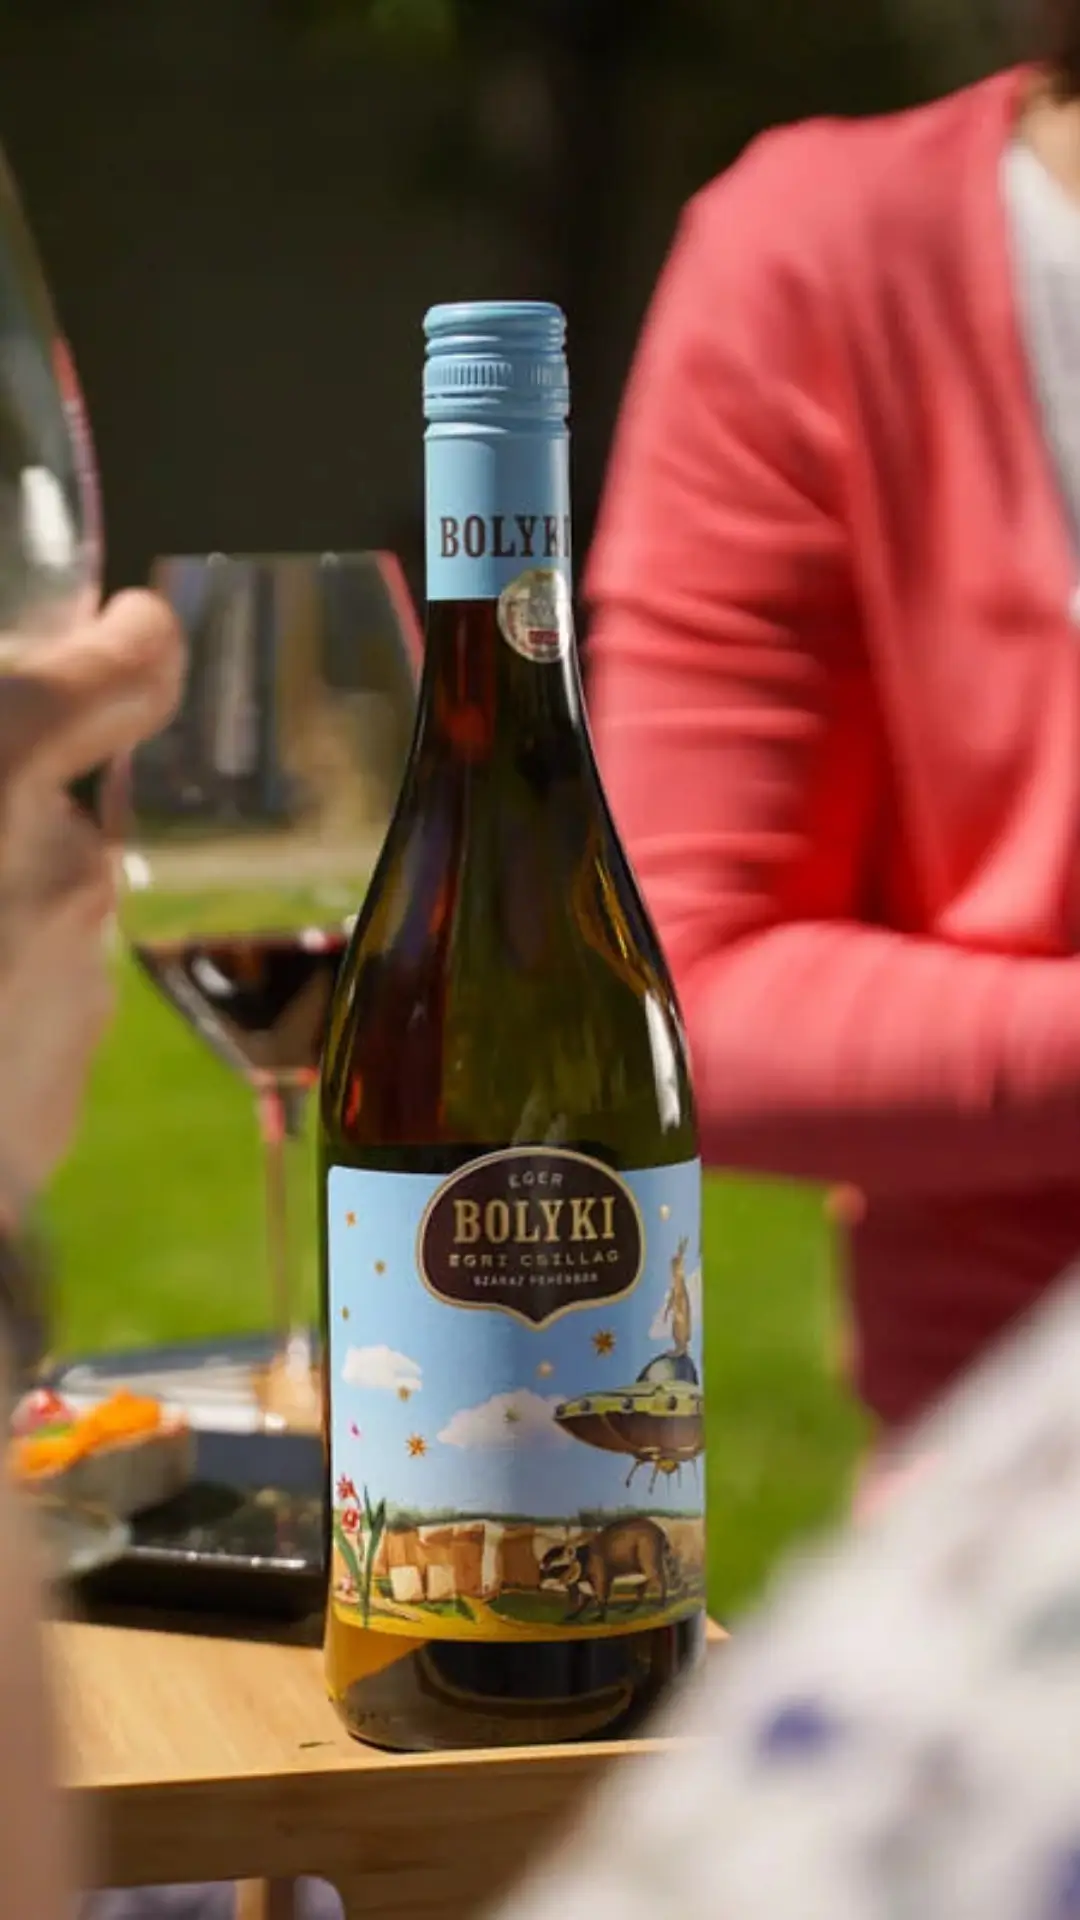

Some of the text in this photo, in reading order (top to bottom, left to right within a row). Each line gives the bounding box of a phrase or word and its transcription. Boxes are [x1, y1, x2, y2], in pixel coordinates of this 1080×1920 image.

[509, 1171, 563, 1189] EGER
[452, 1197, 616, 1244] BOLYKI
[449, 1250, 620, 1268] EGRI CSILLAG
